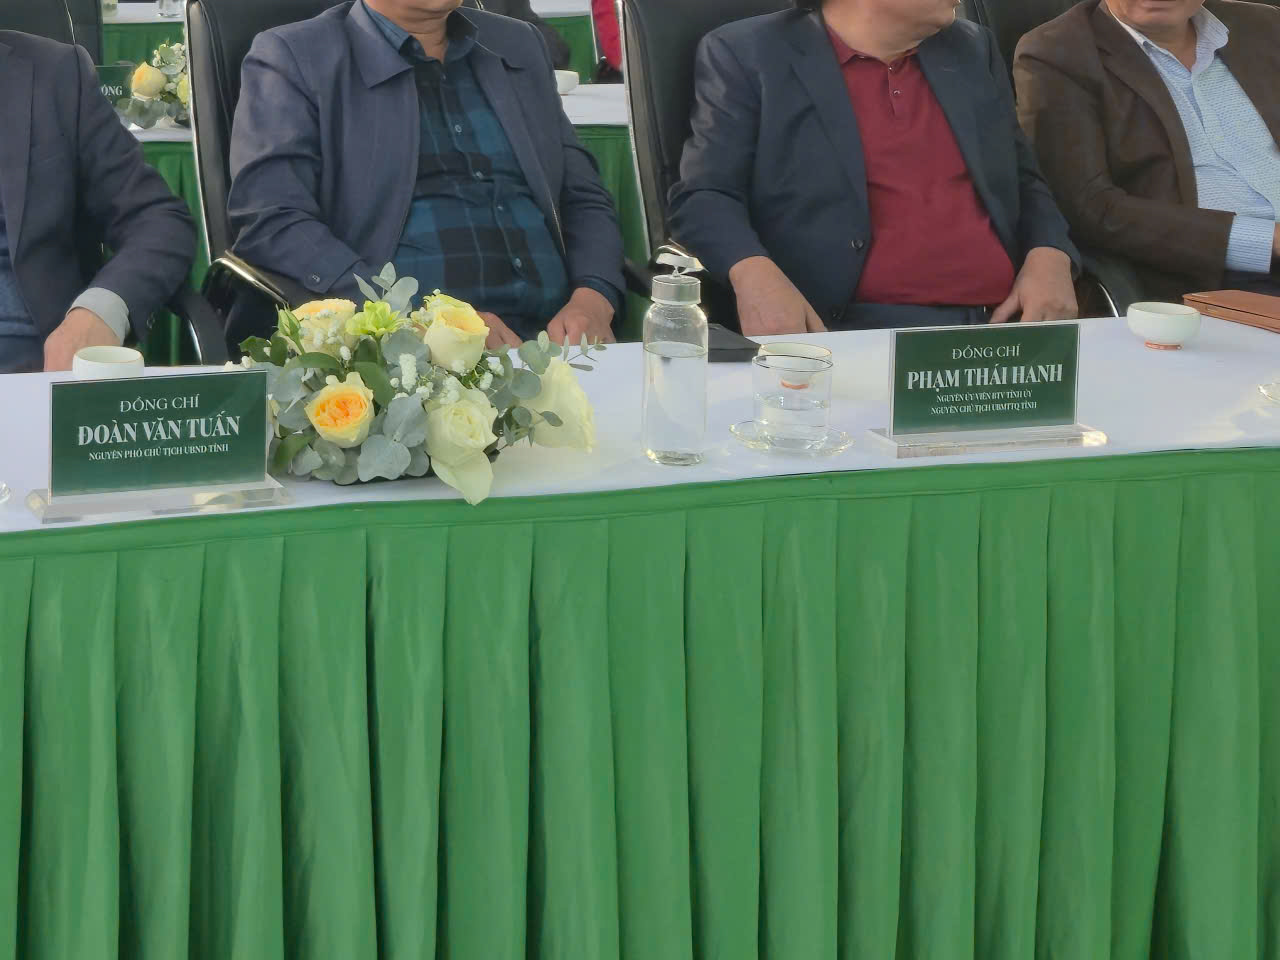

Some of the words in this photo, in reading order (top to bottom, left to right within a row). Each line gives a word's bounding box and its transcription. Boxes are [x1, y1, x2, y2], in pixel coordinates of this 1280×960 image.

[996, 343, 1021, 358] CHÍ
[907, 369, 960, 393] PHẠM
[964, 363, 1008, 387] THÁI
[1012, 363, 1063, 385] HANH
[172, 393, 200, 409] CHÍ
[78, 419, 138, 446] ĐOÀN
[142, 416, 182, 441] VĂN
[187, 410, 241, 438] TUẤN
[184, 444, 207, 455] UBND
